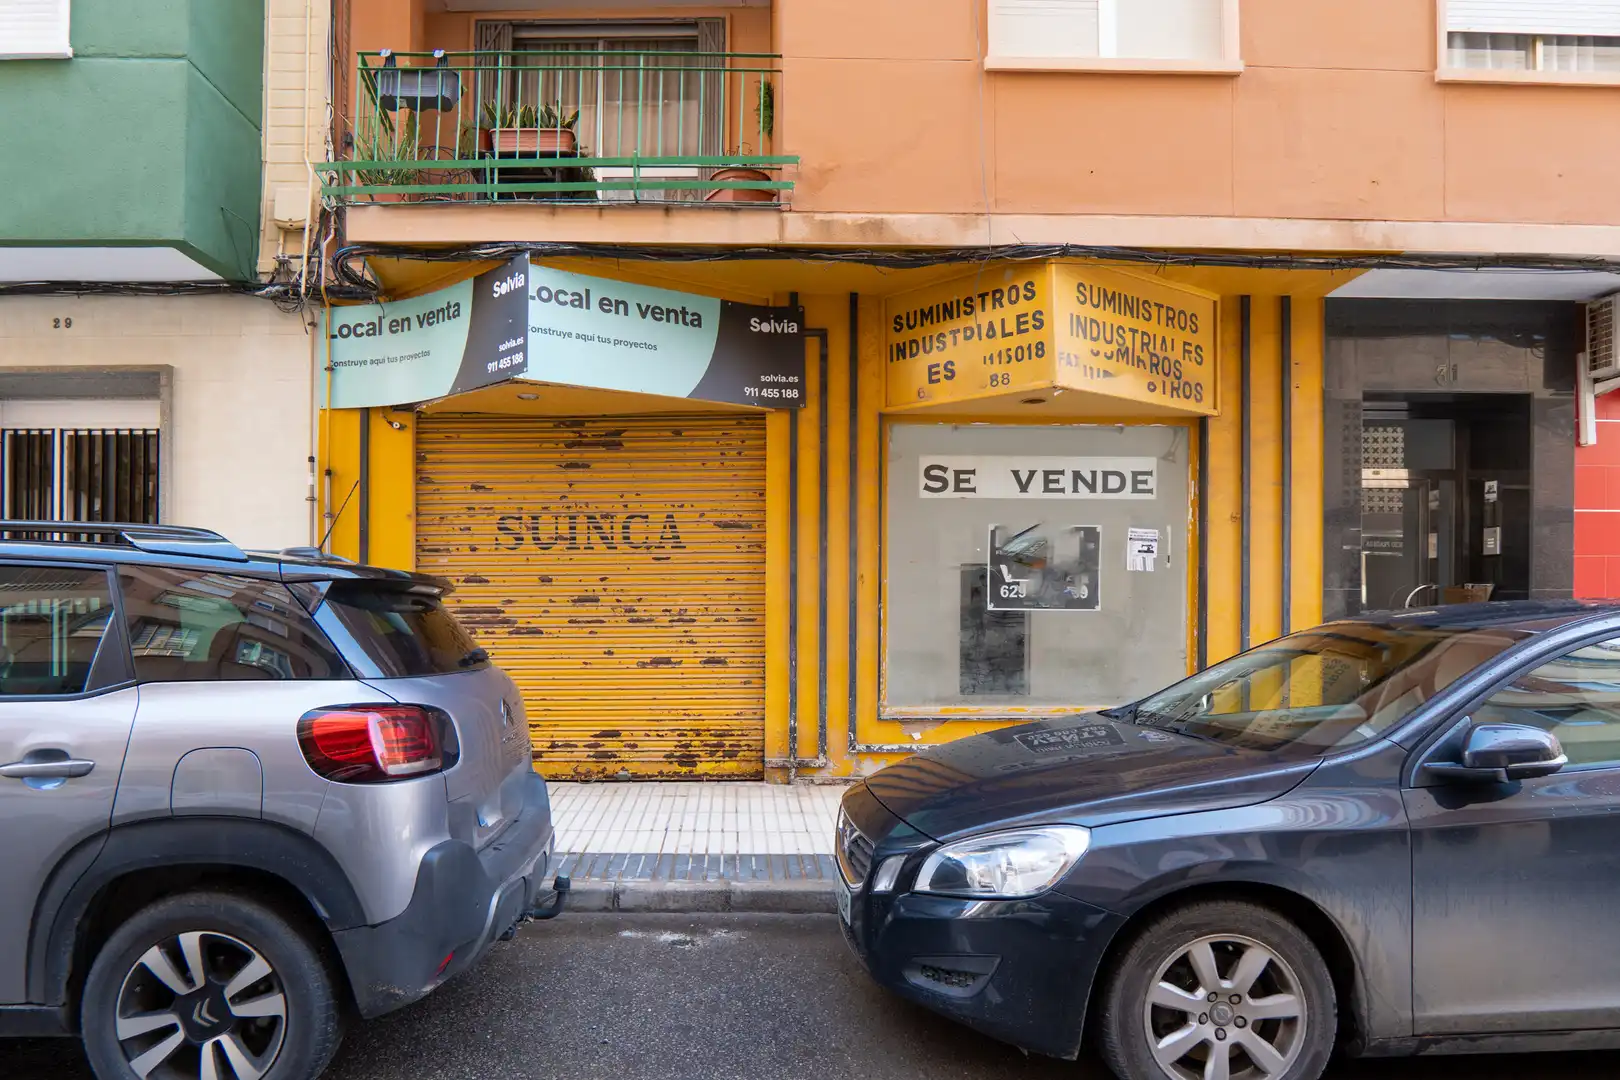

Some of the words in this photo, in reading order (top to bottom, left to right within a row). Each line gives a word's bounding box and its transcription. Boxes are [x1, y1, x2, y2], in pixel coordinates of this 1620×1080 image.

[492, 272, 525, 298] Solvia
[388, 315, 412, 334] en
[416, 300, 461, 329] venta
[529, 285, 591, 310] ocal
[598, 296, 629, 316] en
[636, 302, 703, 328] venta
[893, 280, 1036, 333] SUMINISTROS
[1076, 282, 1199, 334] SUMINISTROS
[53, 317, 72, 329] 29
[749, 317, 798, 333] Solvia
[499, 336, 524, 352] solvia.es
[530, 324, 573, 339] onstruye
[597, 335, 612, 344] tus
[613, 337, 658, 351] proyectos
[387, 354, 399, 364] tus
[399, 349, 431, 364] proyectos
[487, 360, 498, 373] 911
[499, 356, 512, 370] 455
[512, 352, 524, 366] 188
[760, 374, 799, 383] solvia.es
[928, 360, 956, 385] ES
[744, 386, 759, 397] 911
[761, 388, 780, 398] 455
[781, 389, 799, 398] 188
[495, 514, 687, 550] SUINCA
